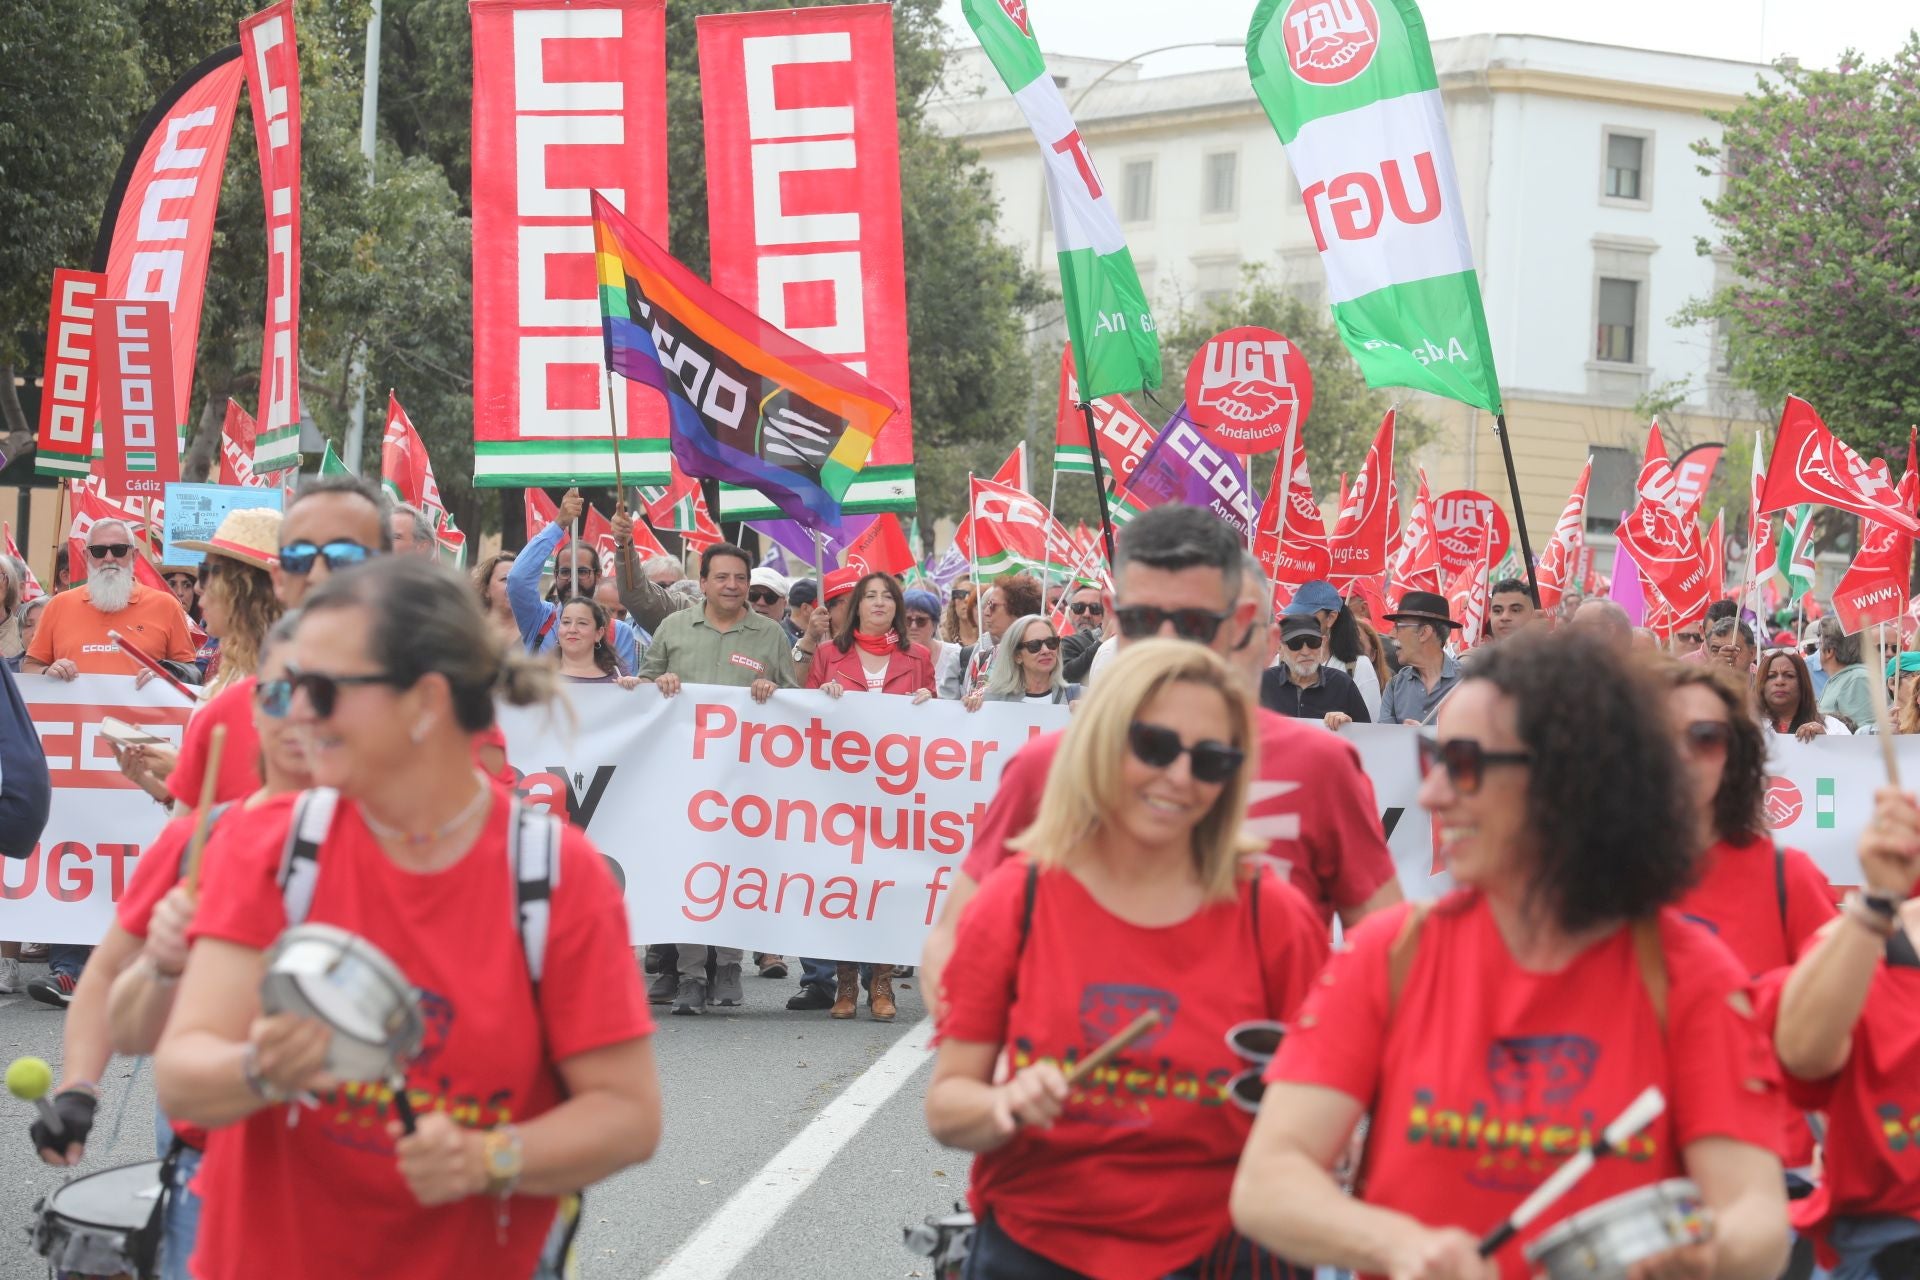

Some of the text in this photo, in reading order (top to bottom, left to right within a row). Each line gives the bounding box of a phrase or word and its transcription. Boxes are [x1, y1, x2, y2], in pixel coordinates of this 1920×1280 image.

[50, 280, 97, 443] CCOO
[116, 306, 157, 447] CCOO
[1203, 341, 1290, 386] UGT
[1215, 422, 1282, 440] Andalucía
[126, 479, 161, 491] Cádiz
[1434, 499, 1494, 531] UGT
[693, 704, 999, 795] Proteger
[0, 841, 140, 902] UGT
[682, 861, 895, 923] ganar
